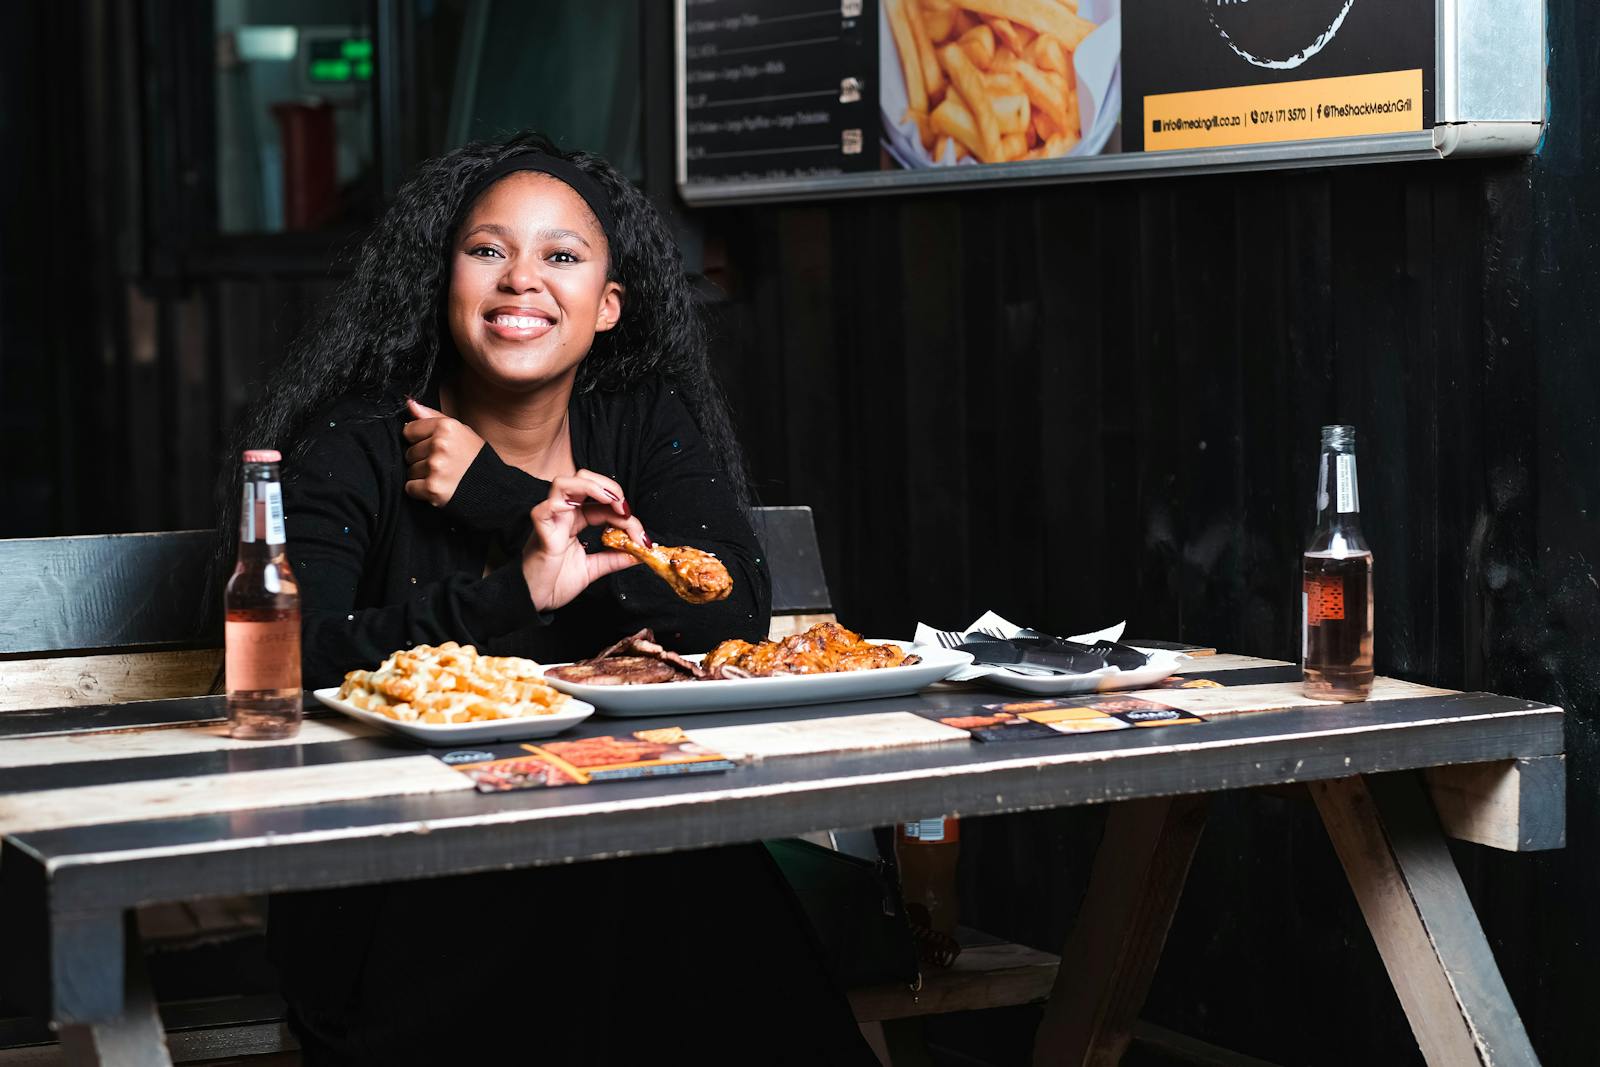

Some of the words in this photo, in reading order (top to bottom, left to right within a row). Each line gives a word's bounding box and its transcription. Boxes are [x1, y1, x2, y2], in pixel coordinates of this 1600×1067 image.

[1260, 111, 1274, 123] 076
[1276, 109, 1286, 122] 171
[1287, 107, 1307, 121] 3570
